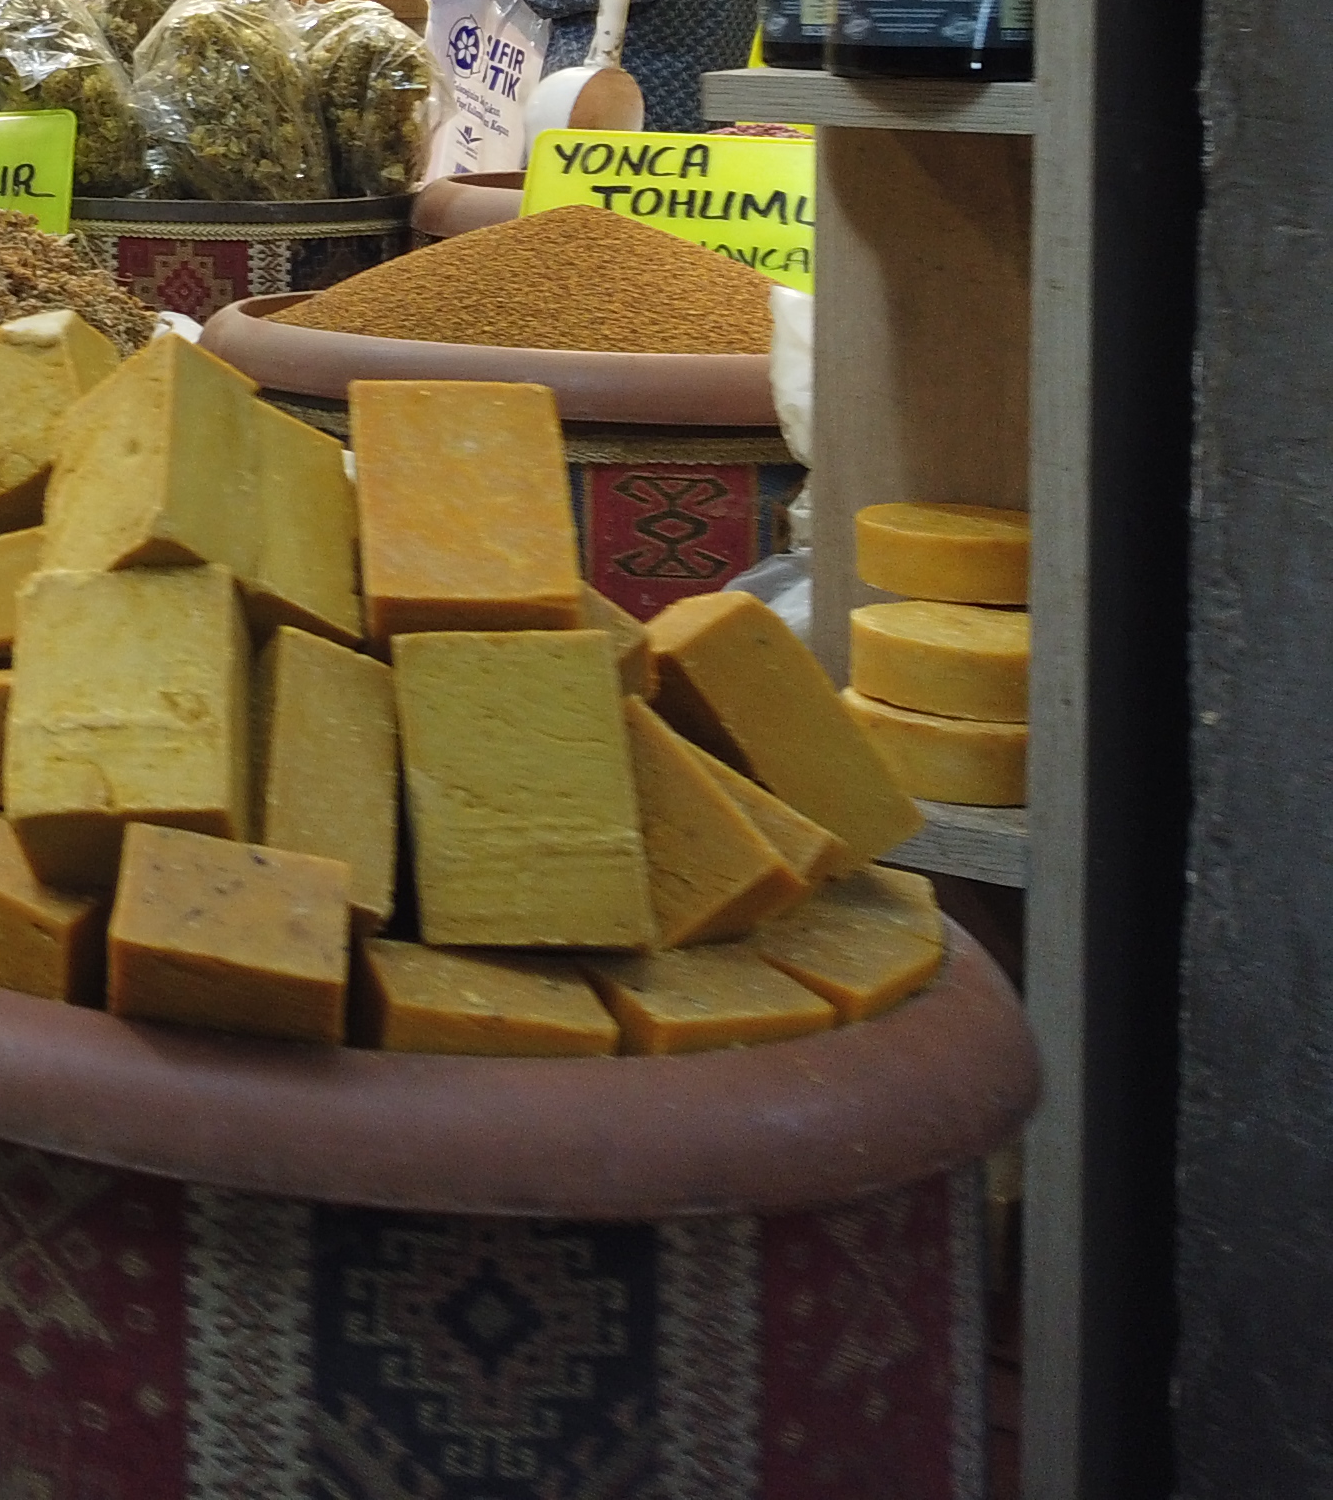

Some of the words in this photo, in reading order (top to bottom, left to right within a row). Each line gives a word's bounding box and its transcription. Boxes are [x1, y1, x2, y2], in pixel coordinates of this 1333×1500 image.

[482, 65, 521, 102] TIK
[554, 143, 710, 179] YONCA
[699, 241, 811, 274] ONCA
